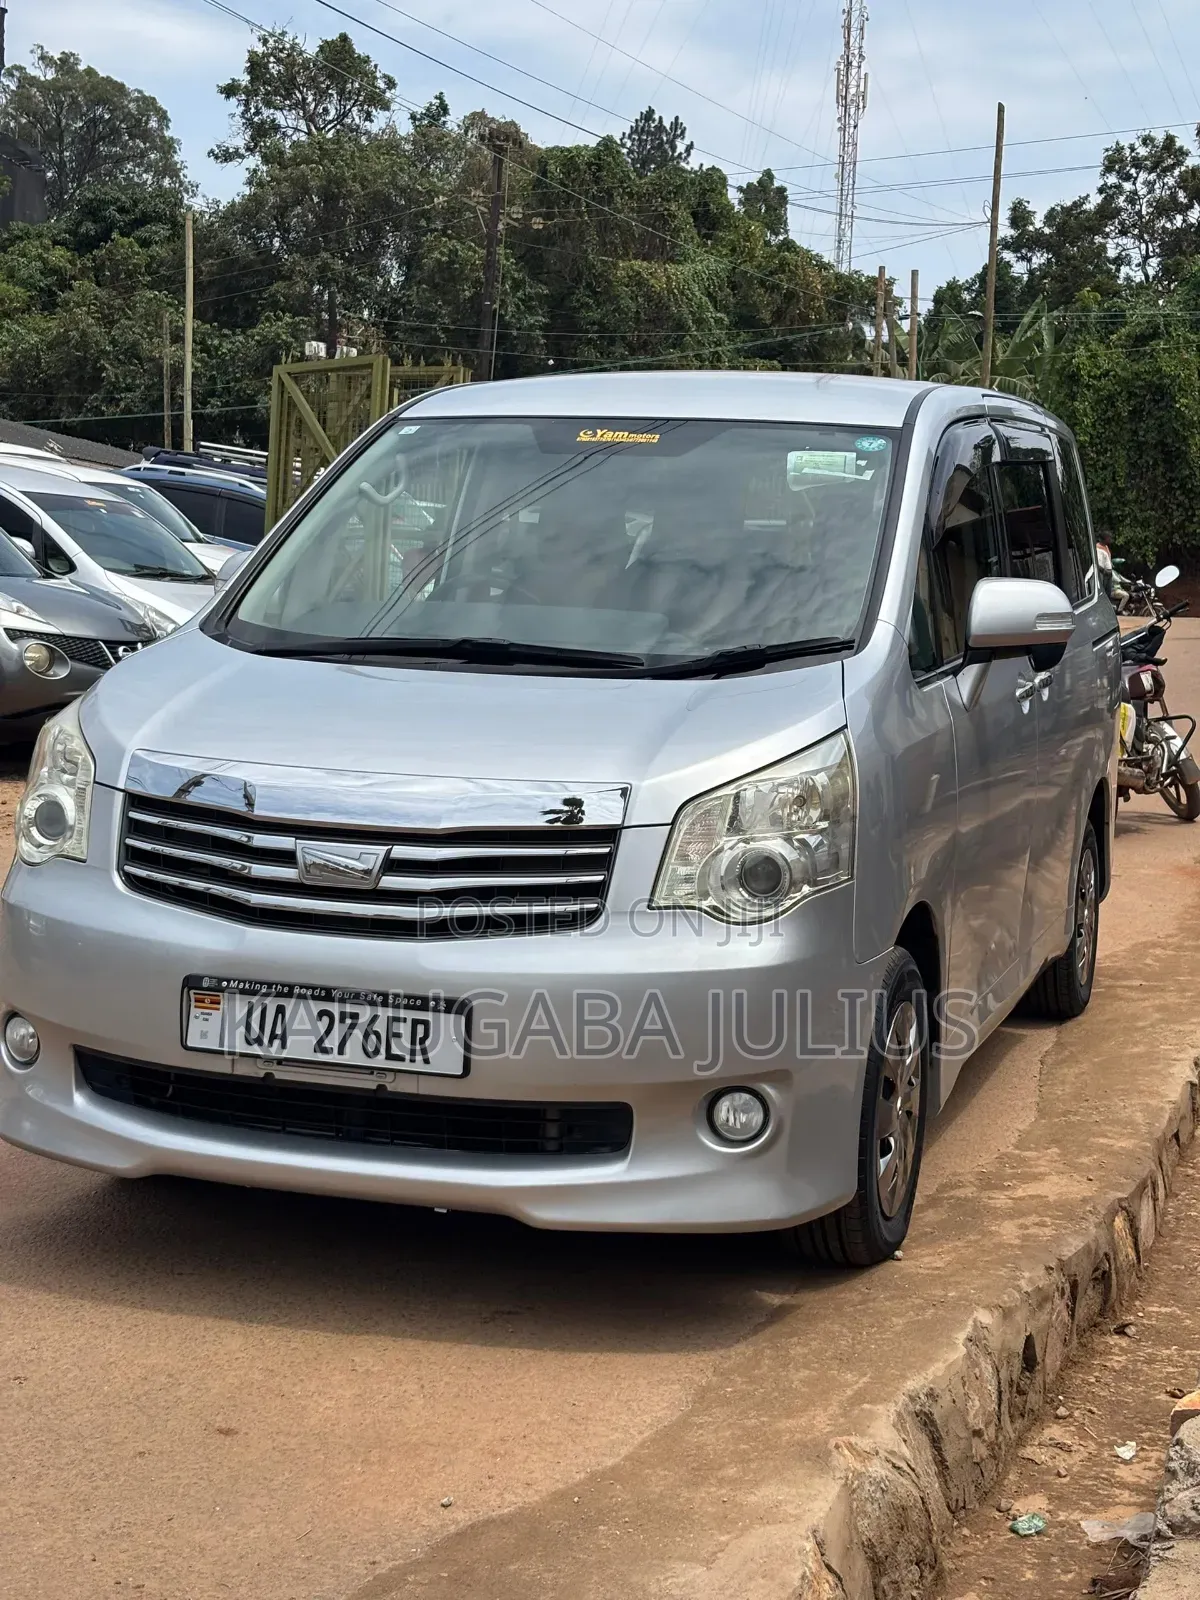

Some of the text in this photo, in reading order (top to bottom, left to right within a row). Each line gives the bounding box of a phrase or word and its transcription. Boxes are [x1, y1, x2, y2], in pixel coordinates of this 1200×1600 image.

[595, 429, 630, 440] Yam
[228, 980, 267, 992] Making
[271, 983, 289, 993] the
[293, 985, 326, 996] Roads
[331, 989, 355, 999] Your
[359, 991, 384, 1002] Safe
[388, 995, 422, 1005] Space
[244, 1000, 431, 1065] UA 276ER
